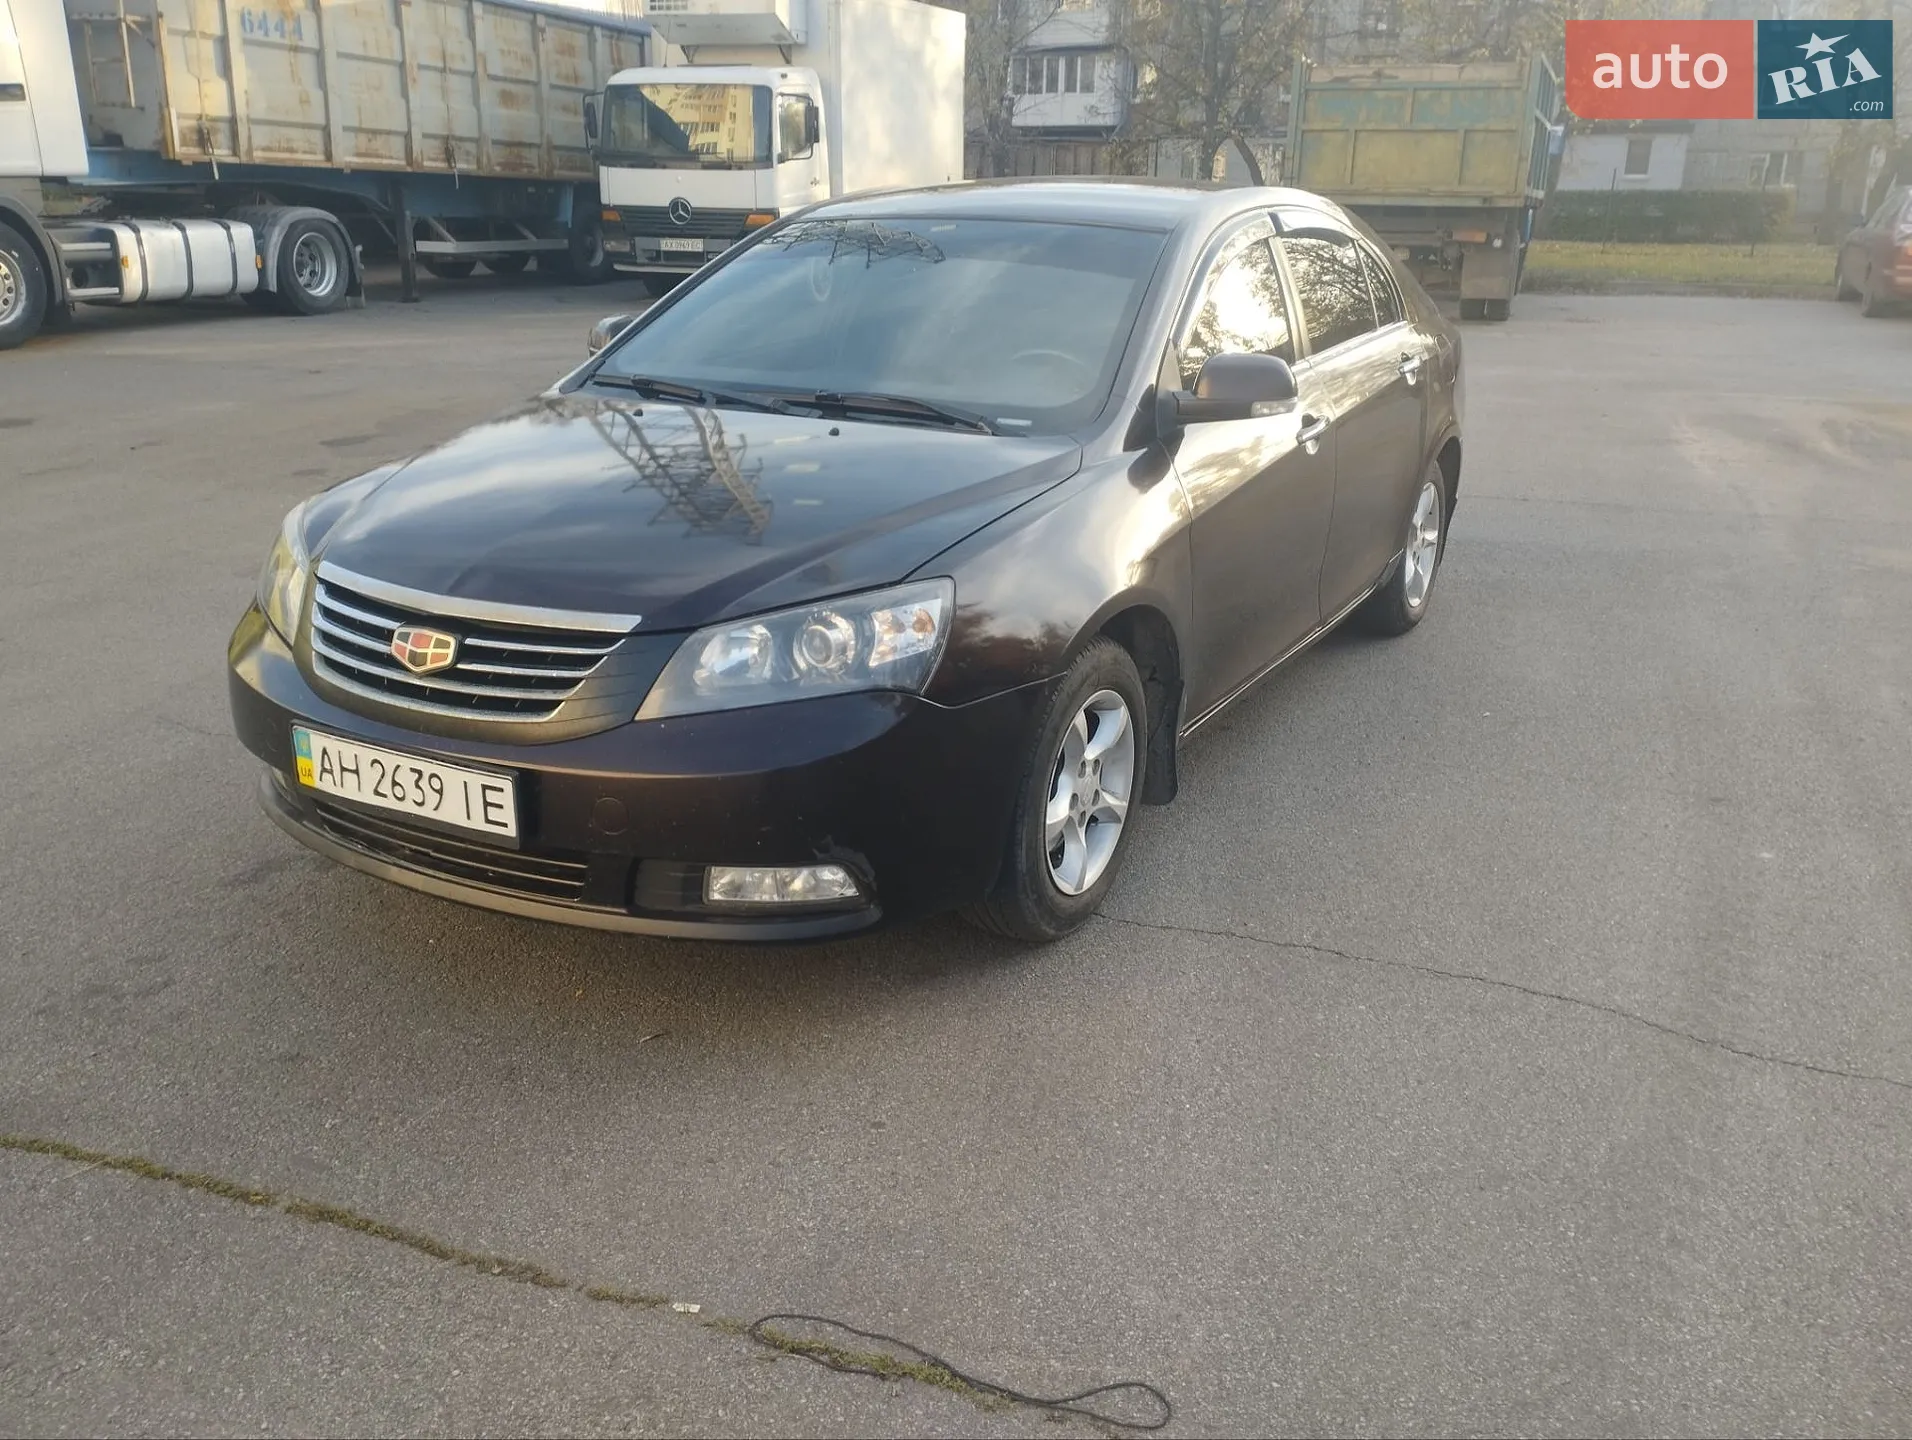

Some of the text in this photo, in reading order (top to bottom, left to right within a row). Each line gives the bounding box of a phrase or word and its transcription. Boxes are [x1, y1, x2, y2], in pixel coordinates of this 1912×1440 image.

[301, 765, 313, 779] UA
[319, 746, 508, 829] AH 2639 IE
